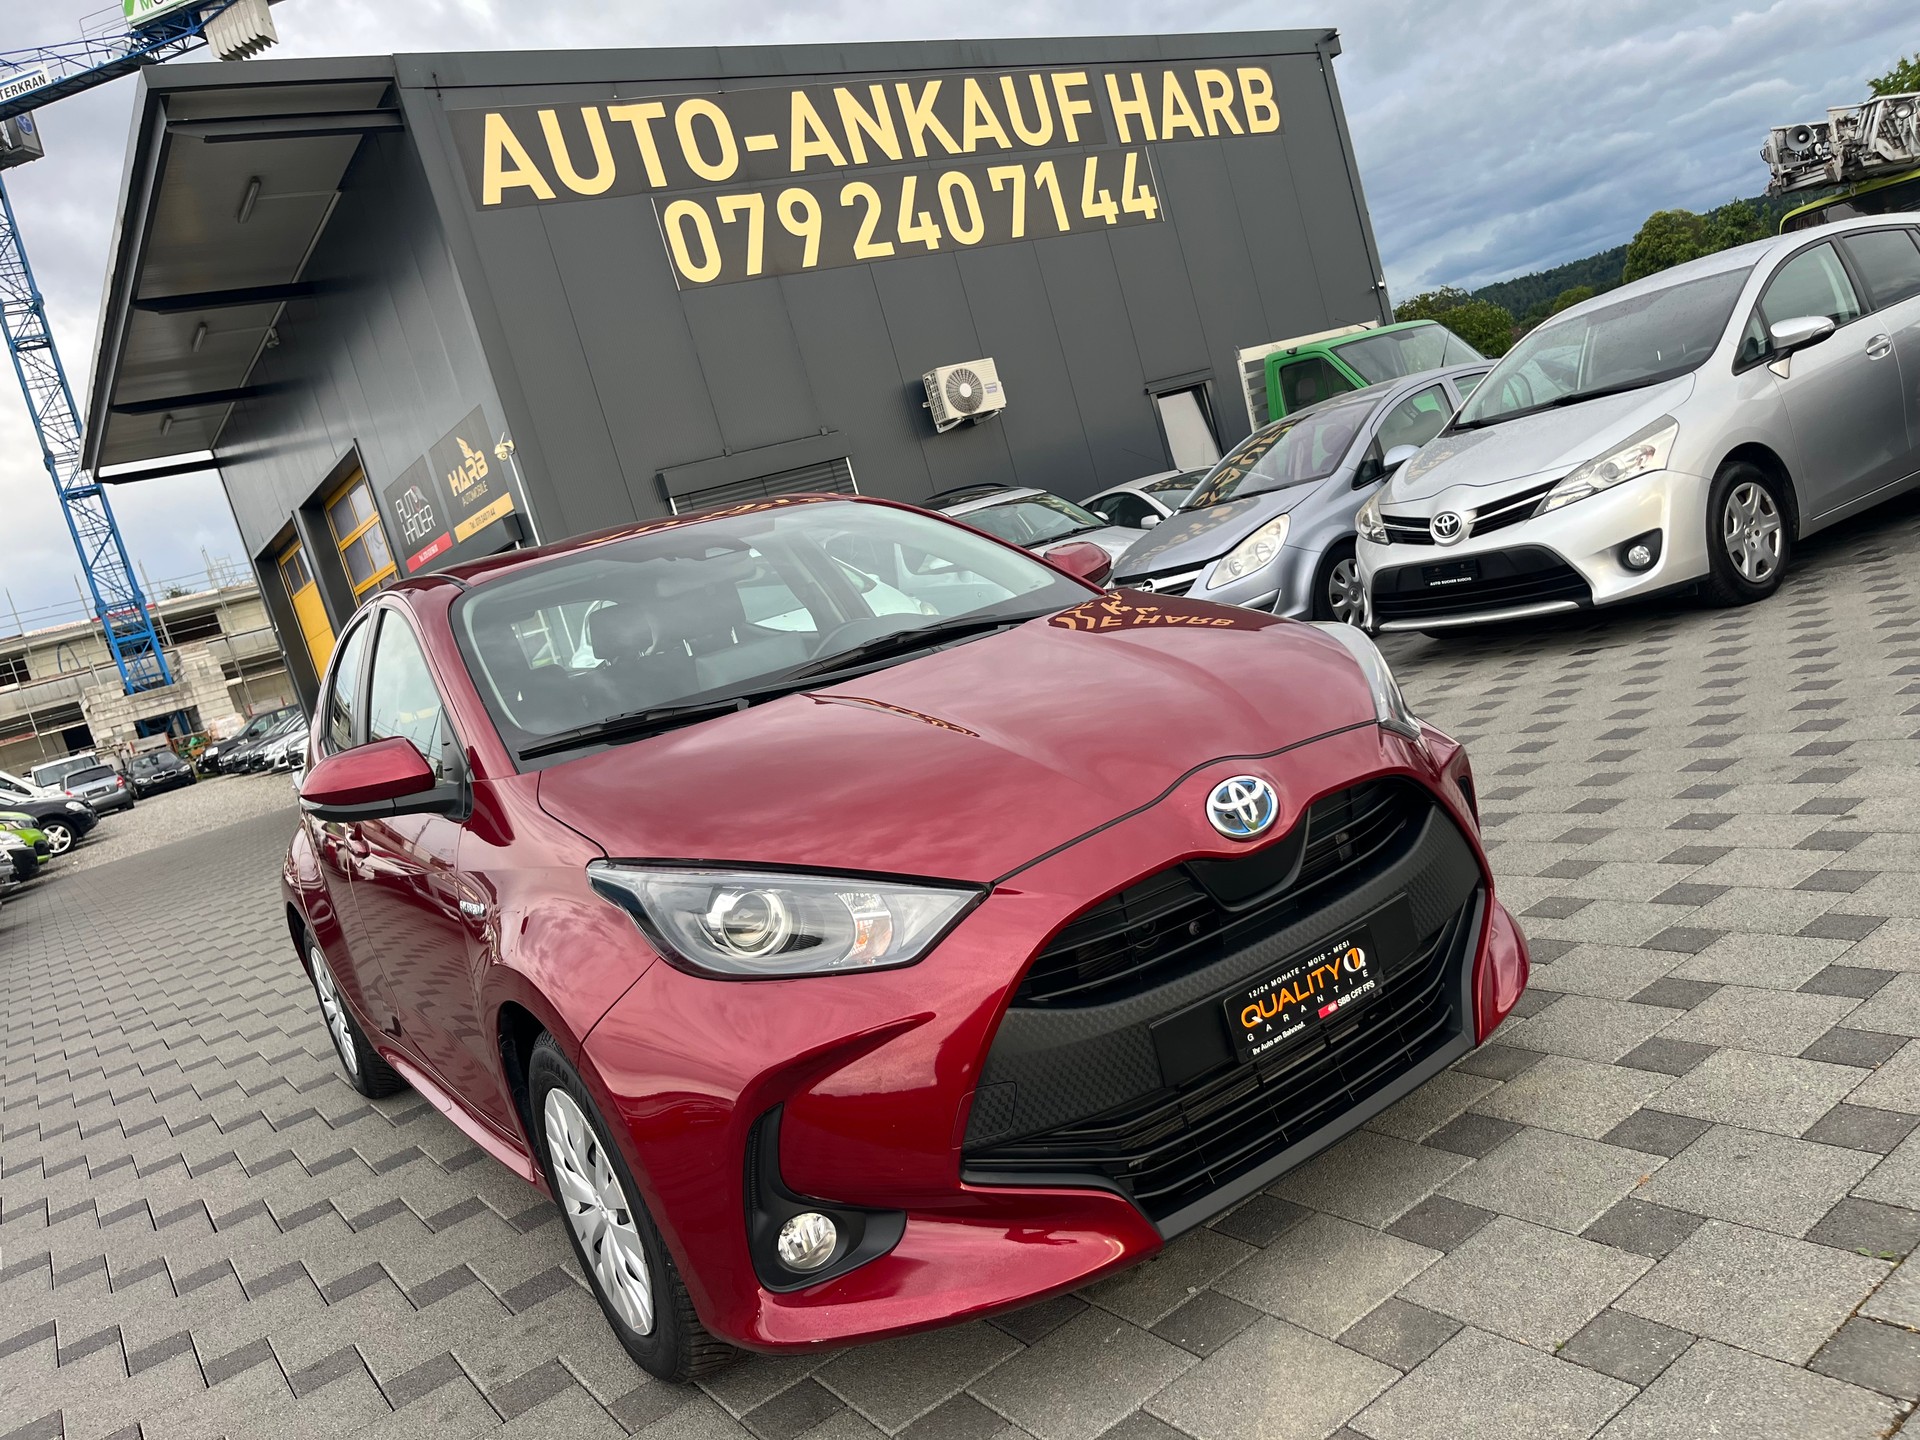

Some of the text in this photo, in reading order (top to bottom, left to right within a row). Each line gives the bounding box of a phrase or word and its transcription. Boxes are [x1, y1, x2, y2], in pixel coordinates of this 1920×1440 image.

[483, 67, 1281, 206] AUTO-ANKAUF HARB
[663, 187, 823, 285] 079
[839, 170, 986, 261] 240
[447, 450, 489, 497] HARB
[1241, 957, 1341, 1028] QUALITY
[1248, 983, 1269, 999] 12/24
[1270, 967, 1300, 987] MONATE
[1307, 953, 1326, 967] MOIS
[1332, 940, 1350, 953] MESI
[1337, 994, 1351, 1007] SBB
[1260, 1039, 1274, 1051] Auto
[1273, 1034, 1283, 1044] am
